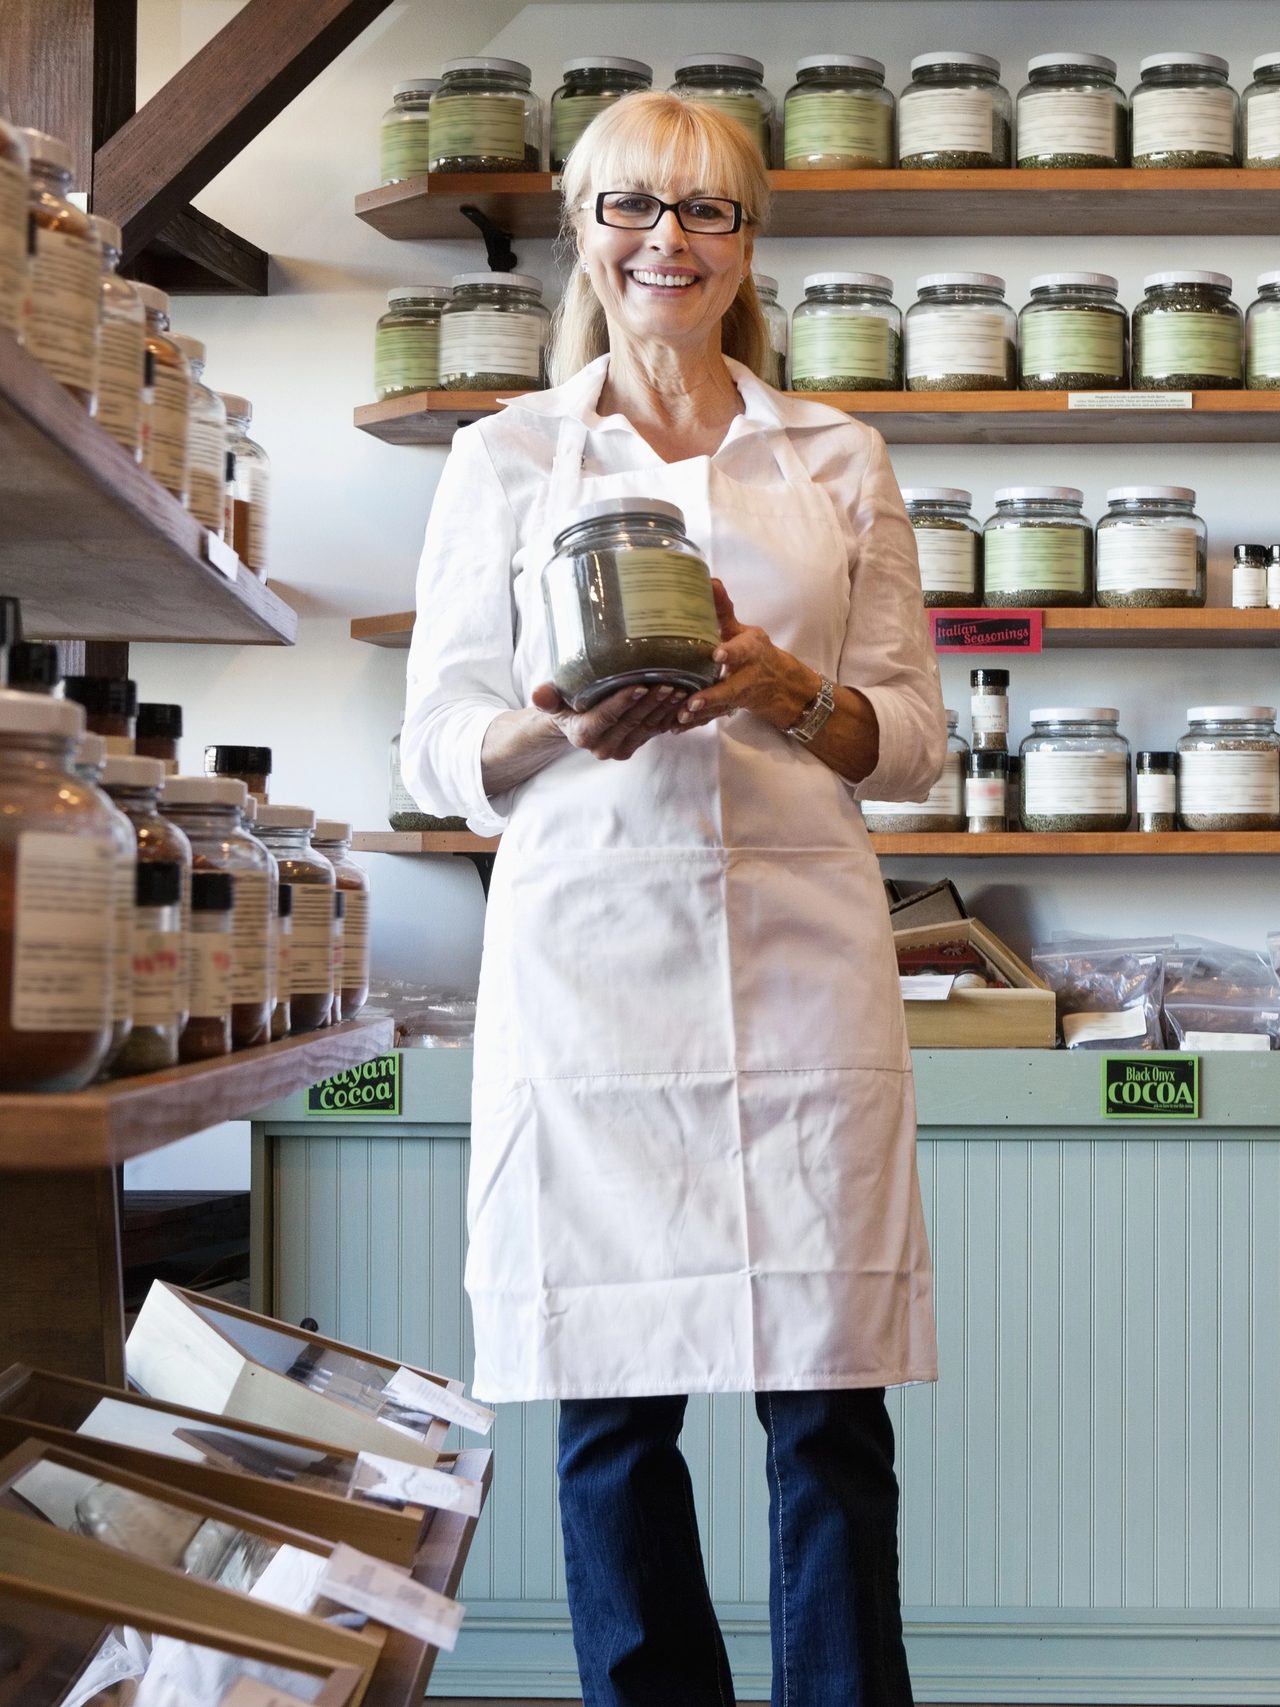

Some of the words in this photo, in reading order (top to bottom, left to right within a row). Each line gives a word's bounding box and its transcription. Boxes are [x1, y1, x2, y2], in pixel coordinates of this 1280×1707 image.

[937, 624, 977, 638] Italian
[963, 627, 1029, 644] Seasonings
[1126, 1066, 1151, 1081] Black
[1152, 1066, 1175, 1083] Onyx
[320, 1082, 393, 1109] Cocoa
[1108, 1081, 1194, 1104] COCOA
